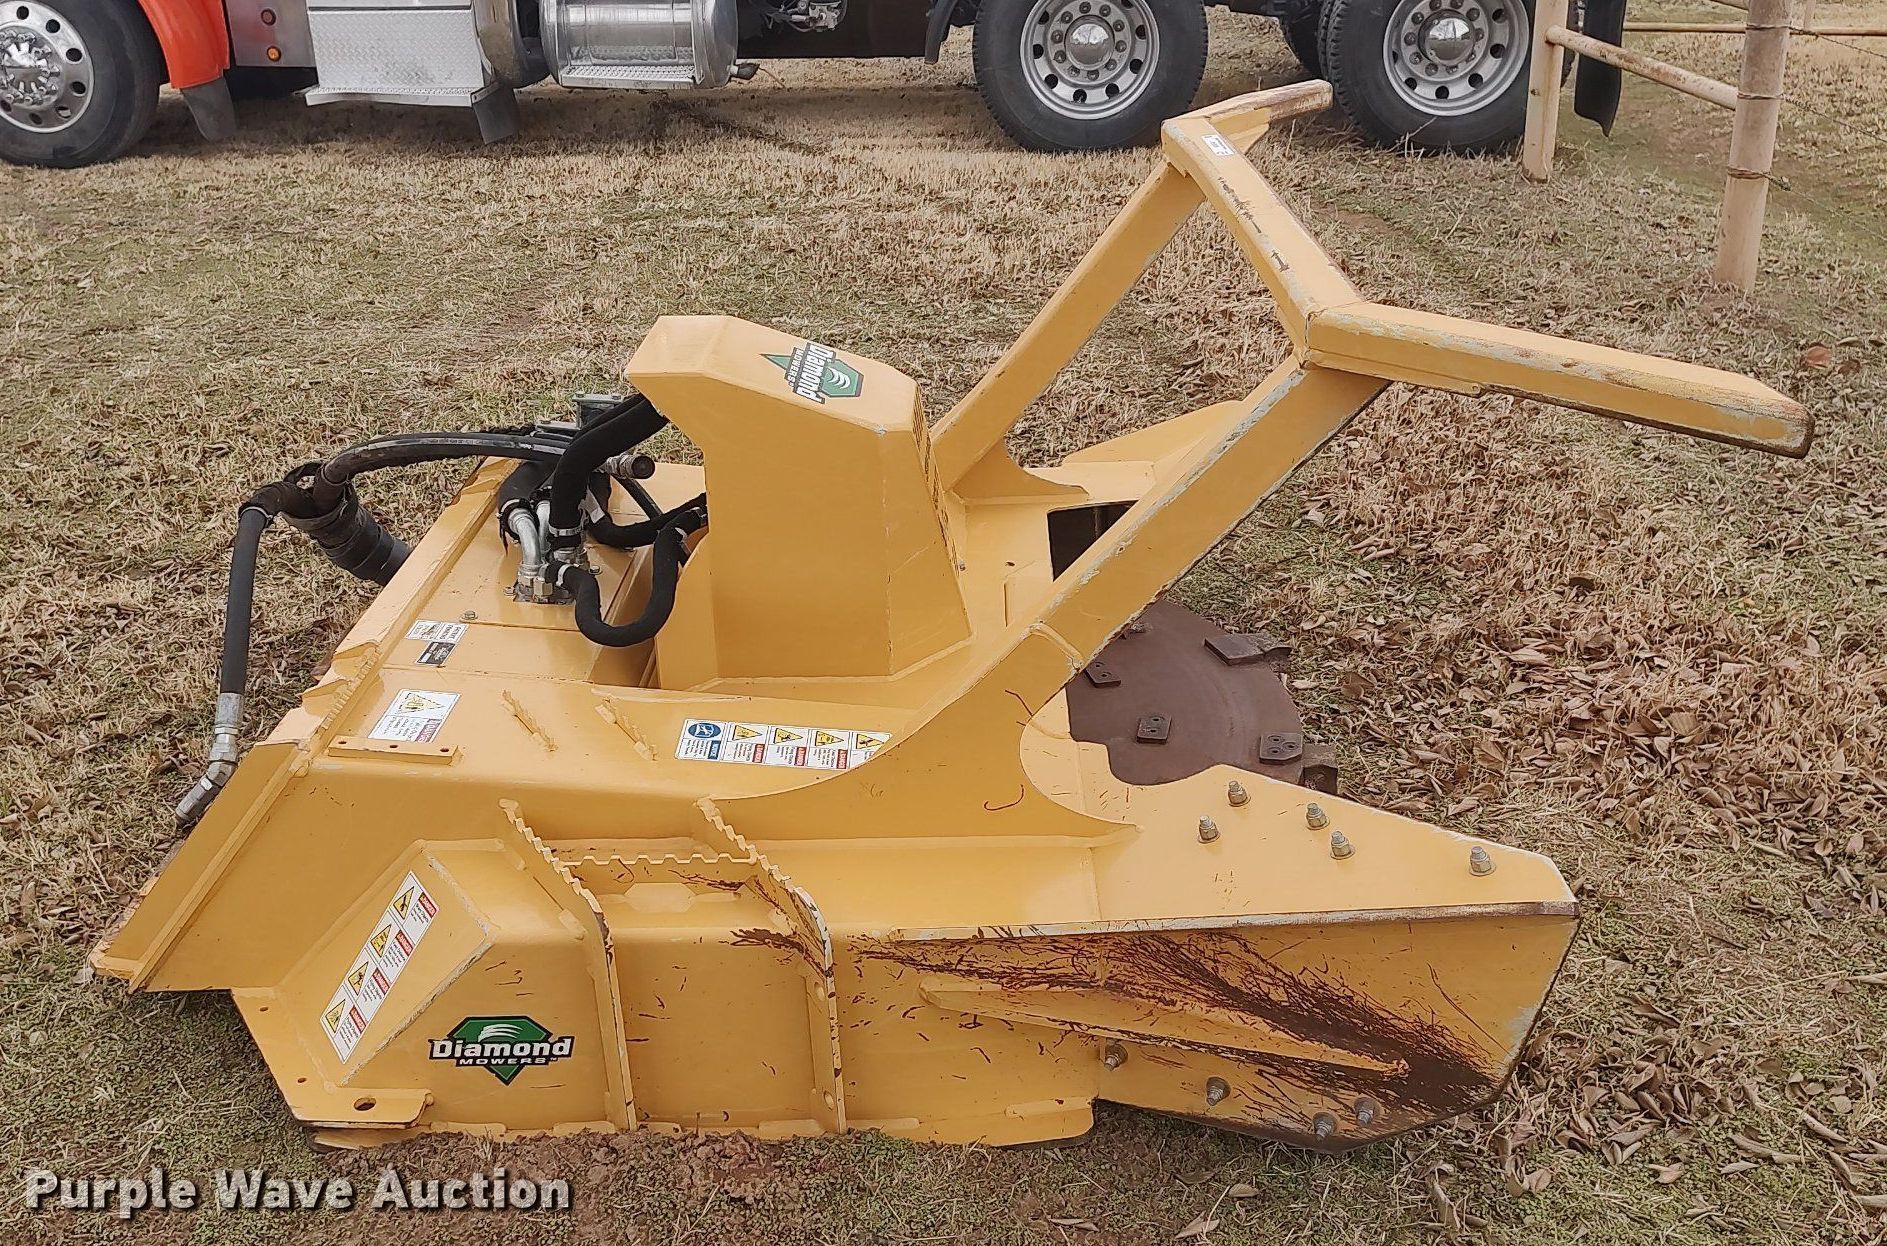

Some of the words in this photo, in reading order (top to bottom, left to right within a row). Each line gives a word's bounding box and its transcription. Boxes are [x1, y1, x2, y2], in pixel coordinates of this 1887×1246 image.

[796, 344, 835, 404] Diamond
[432, 1038, 572, 1058] Diamond
[459, 1057, 547, 1065] MOWERS
